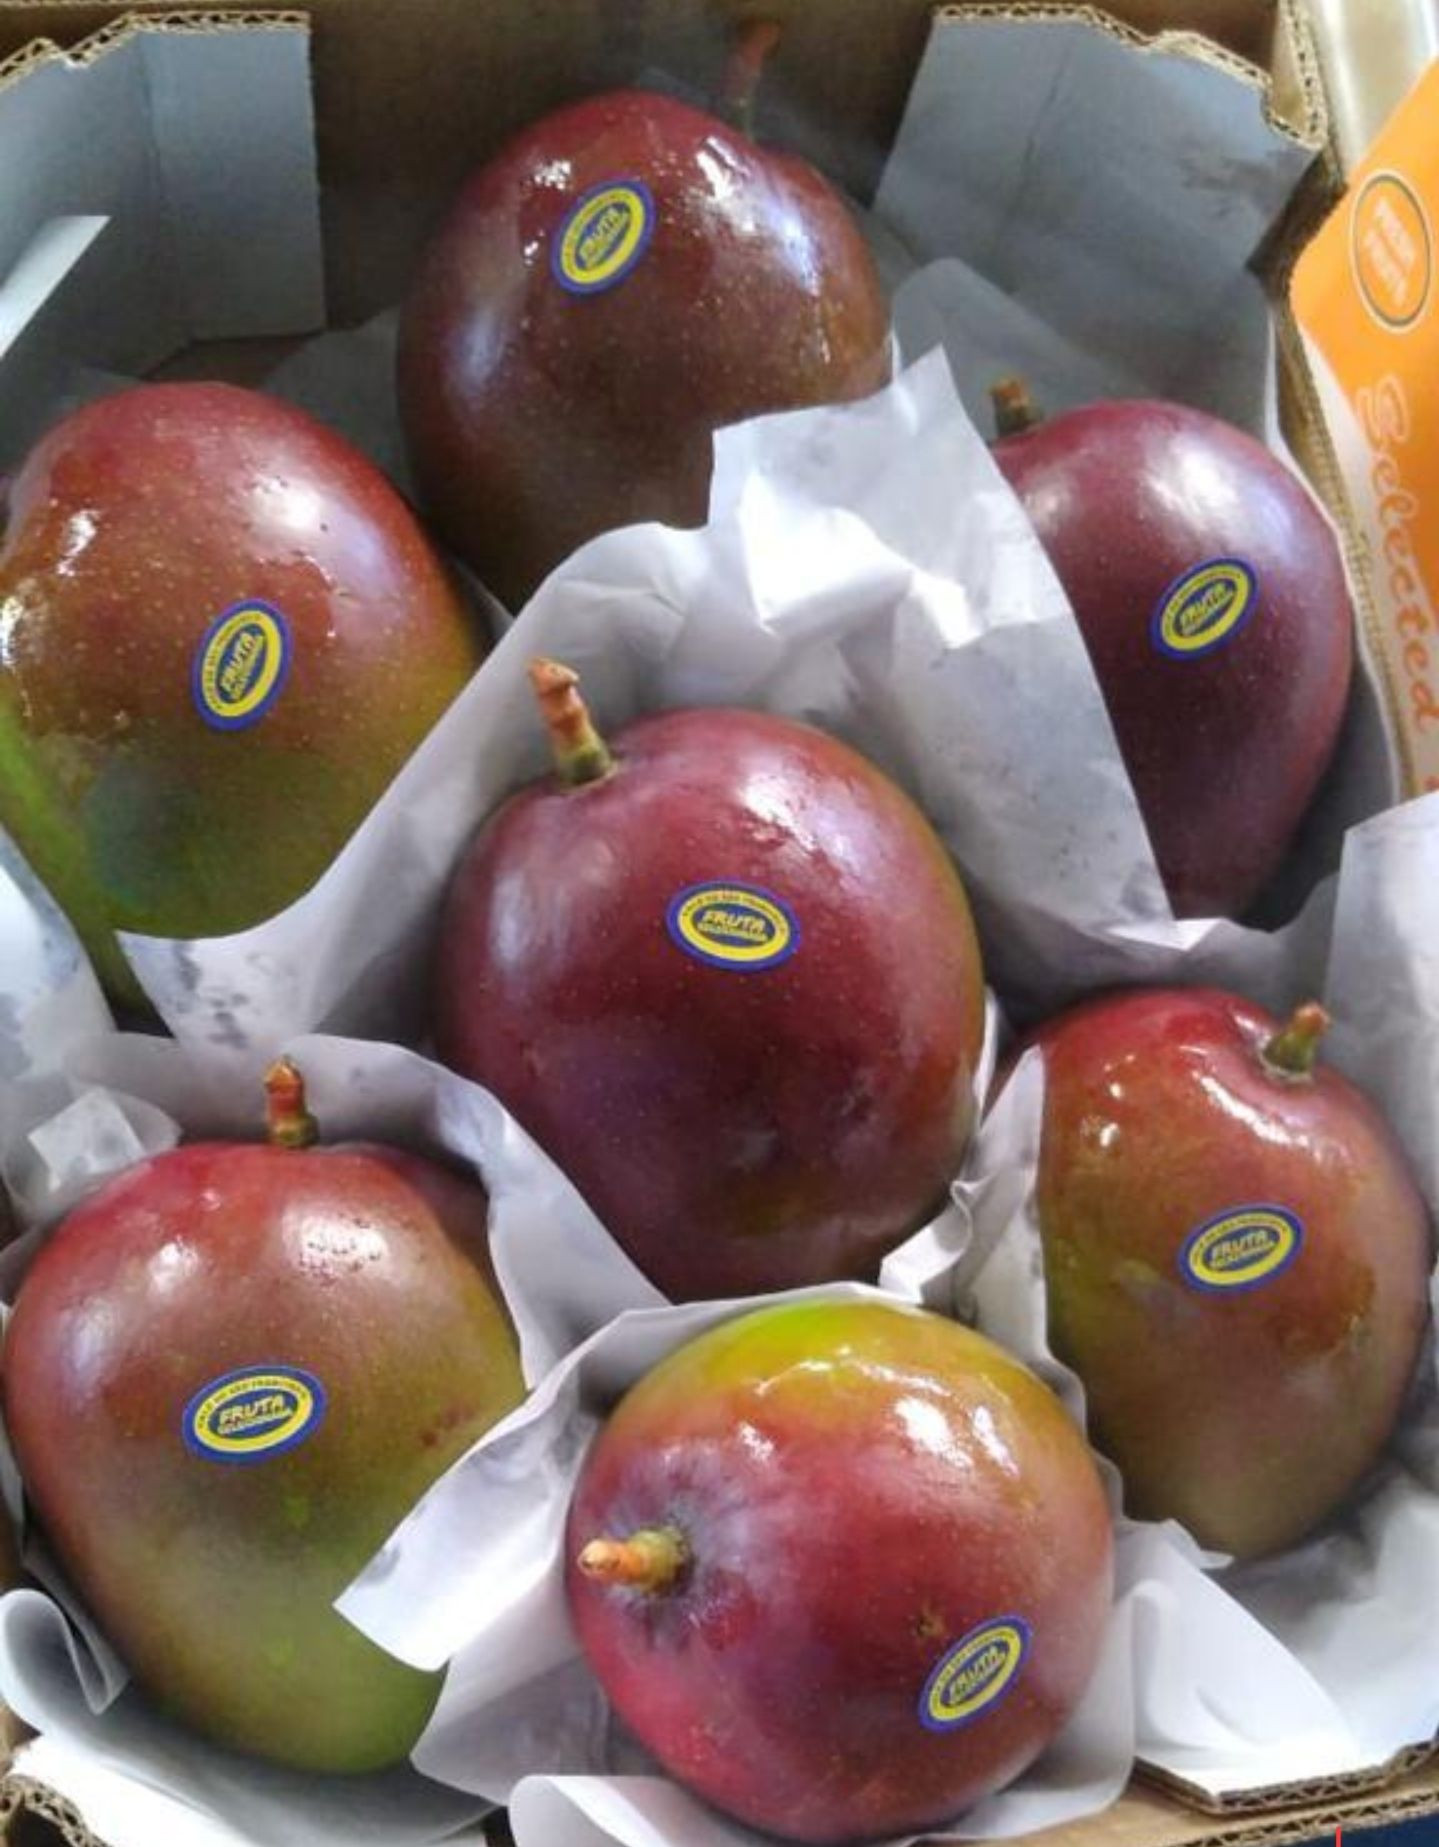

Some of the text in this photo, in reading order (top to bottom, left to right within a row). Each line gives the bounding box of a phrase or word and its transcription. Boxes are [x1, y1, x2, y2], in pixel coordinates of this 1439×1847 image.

[1356, 374, 1438, 735] Selected
[701, 910, 766, 934] FRUTA
[1211, 1230, 1268, 1262] FRUTA
[219, 1395, 285, 1427] FRUTA
